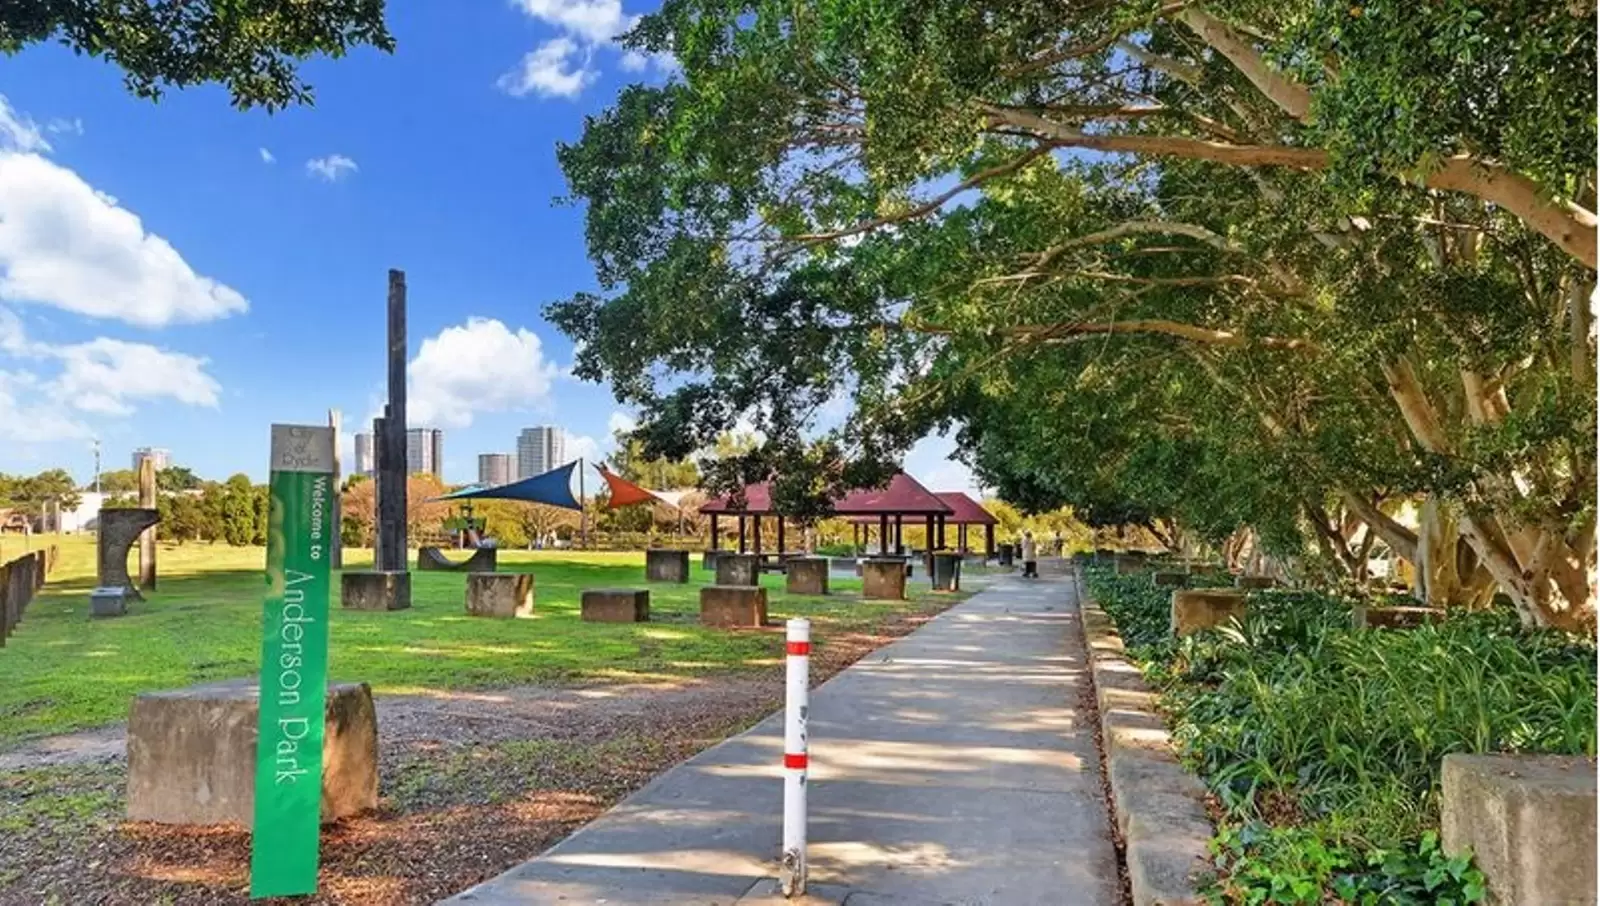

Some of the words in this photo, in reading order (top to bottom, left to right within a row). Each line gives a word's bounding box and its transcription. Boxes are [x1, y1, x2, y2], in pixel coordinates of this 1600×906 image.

[311, 476, 326, 540] Welcome
[310, 544, 322, 560] to
[280, 568, 316, 705] Anderson
[275, 717, 310, 785] Park
